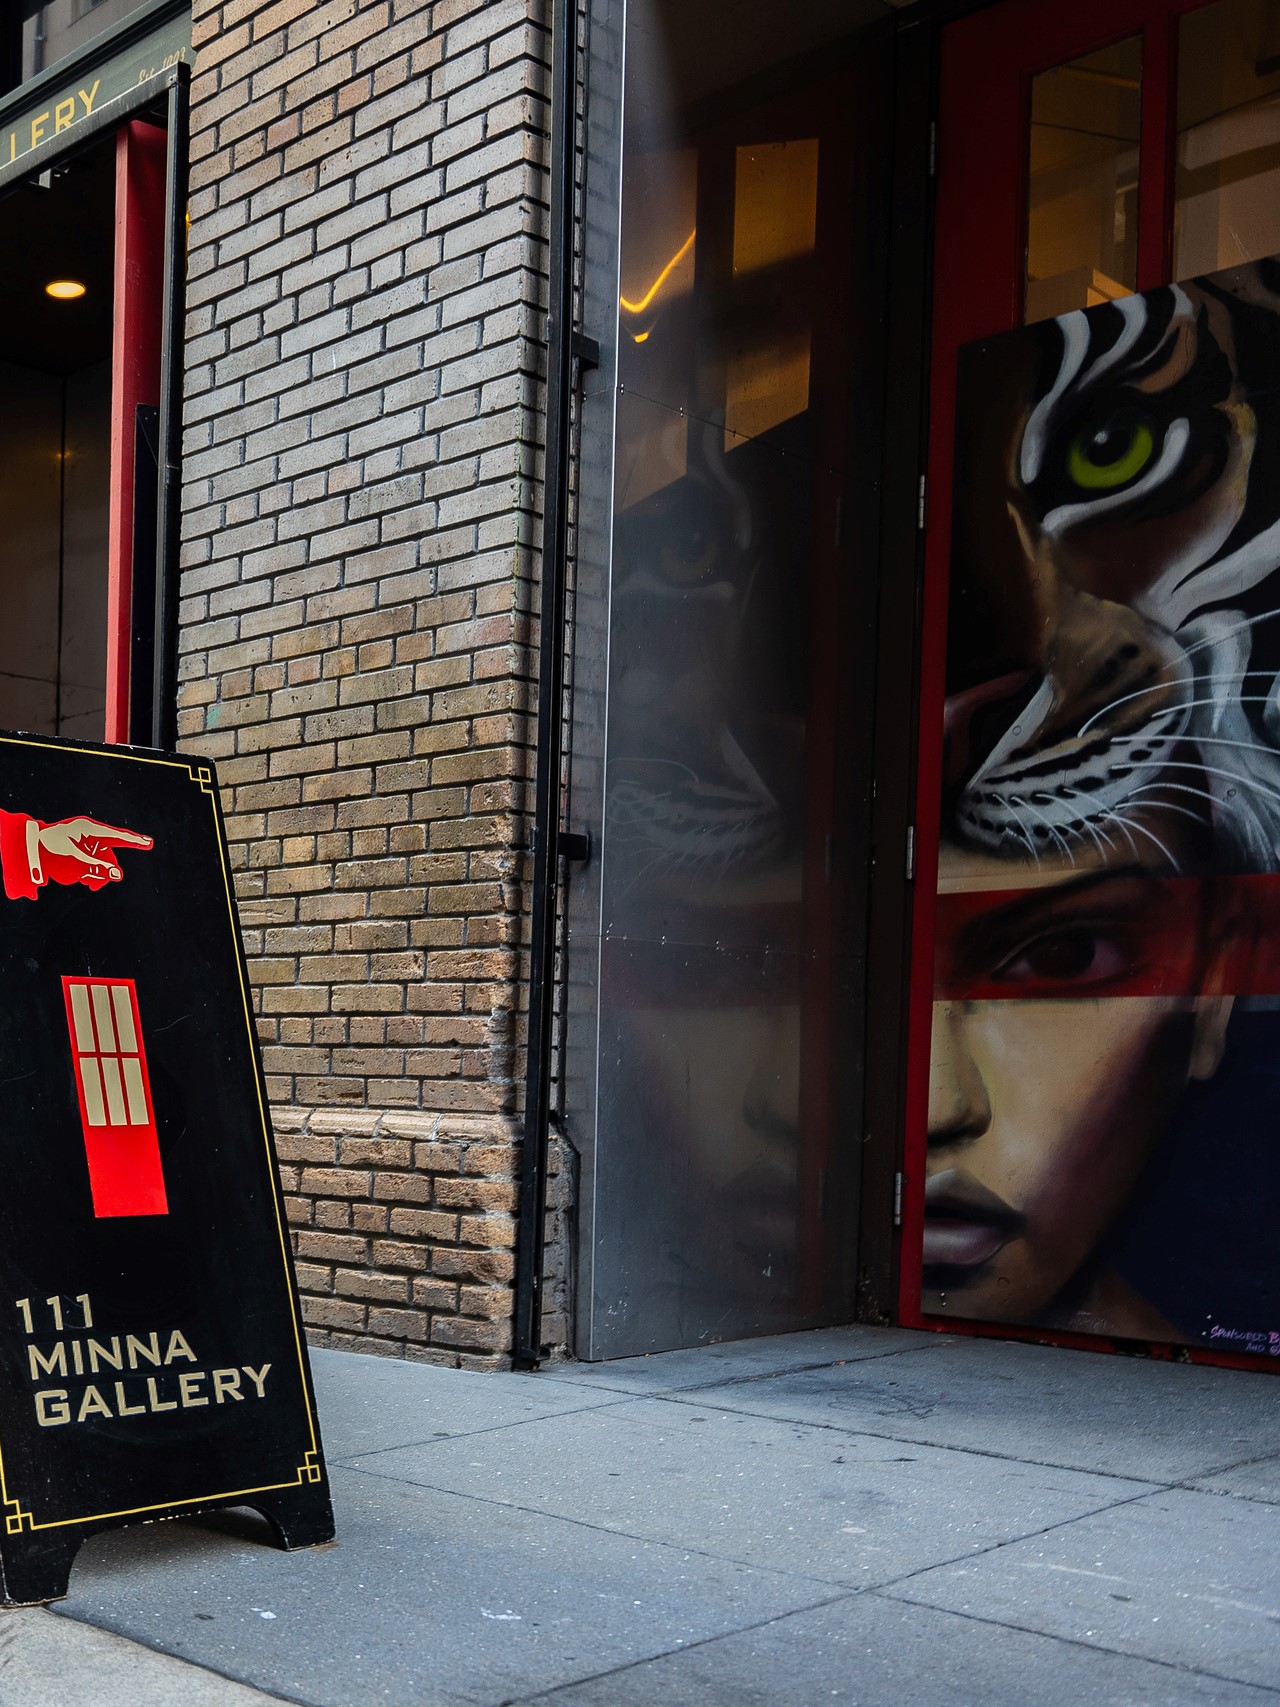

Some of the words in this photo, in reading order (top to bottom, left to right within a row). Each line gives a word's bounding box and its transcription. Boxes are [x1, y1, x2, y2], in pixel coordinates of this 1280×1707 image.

[16, 1293, 93, 1333] 111
[27, 1330, 198, 1380] MINNA
[35, 1363, 272, 1427] GALLERY
